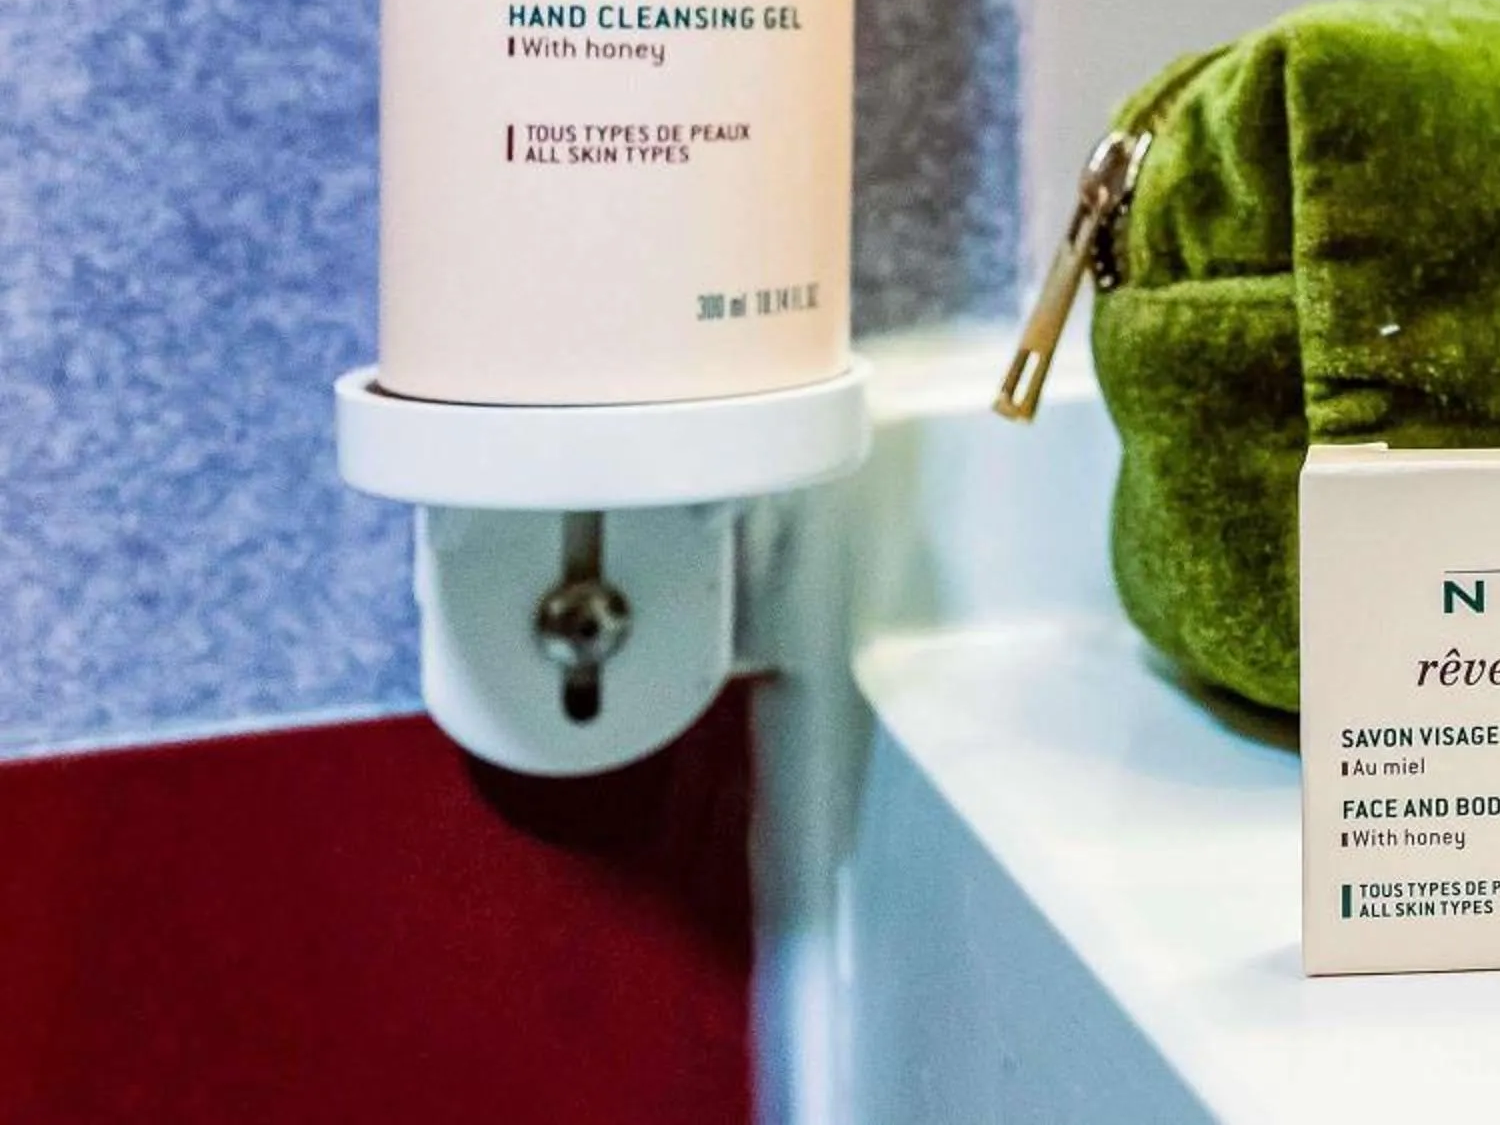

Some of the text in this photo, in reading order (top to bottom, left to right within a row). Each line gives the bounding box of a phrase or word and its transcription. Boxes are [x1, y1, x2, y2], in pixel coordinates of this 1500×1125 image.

[508, 4, 803, 31] HAND CLEANSING GEL
[521, 37, 666, 67] With honey
[526, 123, 751, 143] TOUS TYPES DE PEAUX
[524, 146, 690, 164] ALL SKIN TYPES
[1341, 727, 1414, 749] SAVON
[1420, 725, 1499, 747] VISAGE
[1353, 758, 1426, 776] Au miel
[1342, 799, 1398, 820] FACE
[1403, 799, 1449, 818] AND
[1353, 829, 1466, 850] With honey
[1359, 883, 1403, 899] TOUS
[1407, 882, 1462, 898] TYPES
[1465, 881, 1487, 896] DE
[1358, 900, 1494, 919] ALL SKIN TYPES
